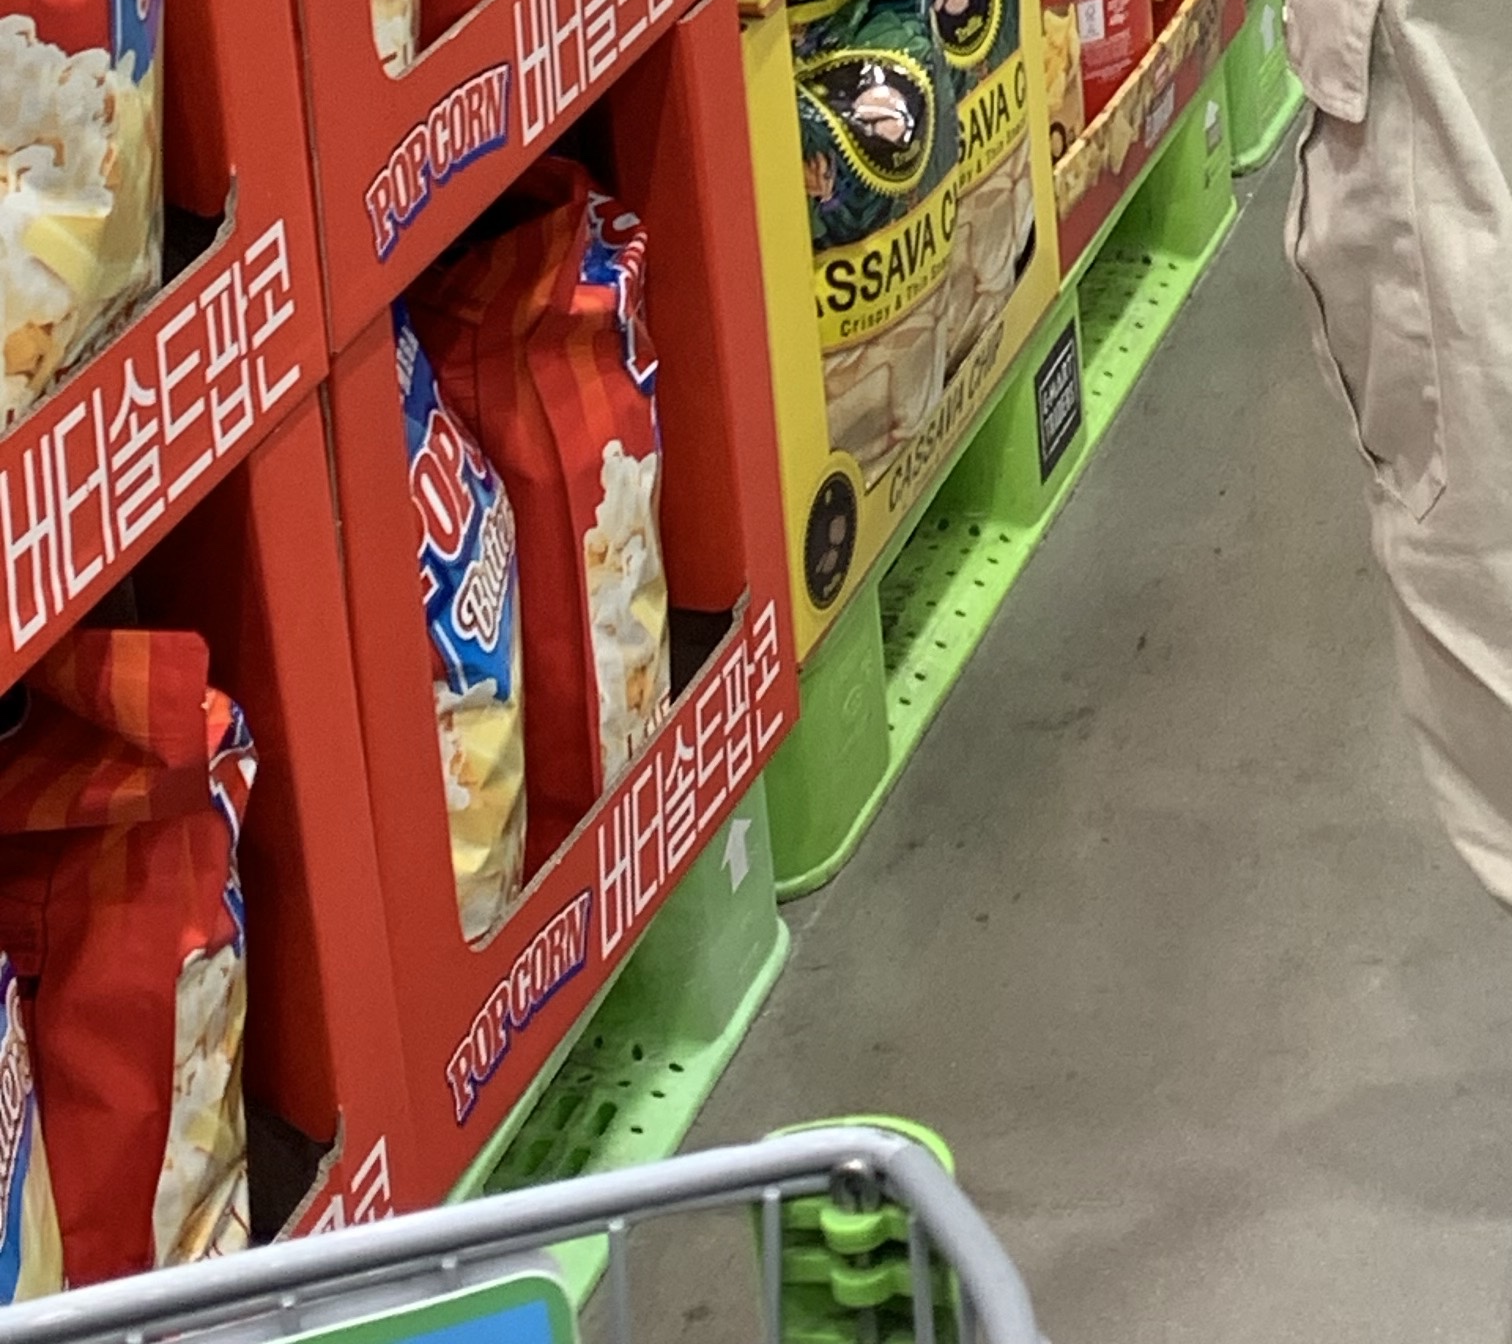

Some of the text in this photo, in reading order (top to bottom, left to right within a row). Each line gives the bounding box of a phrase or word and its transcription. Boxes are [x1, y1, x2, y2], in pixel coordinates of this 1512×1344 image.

[366, 62, 511, 263] POPCORN
[0, 217, 301, 654] 버터솔트팝콘
[597, 599, 784, 962] 버터솔트팝콘
[444, 888, 592, 1127] POPCORN
